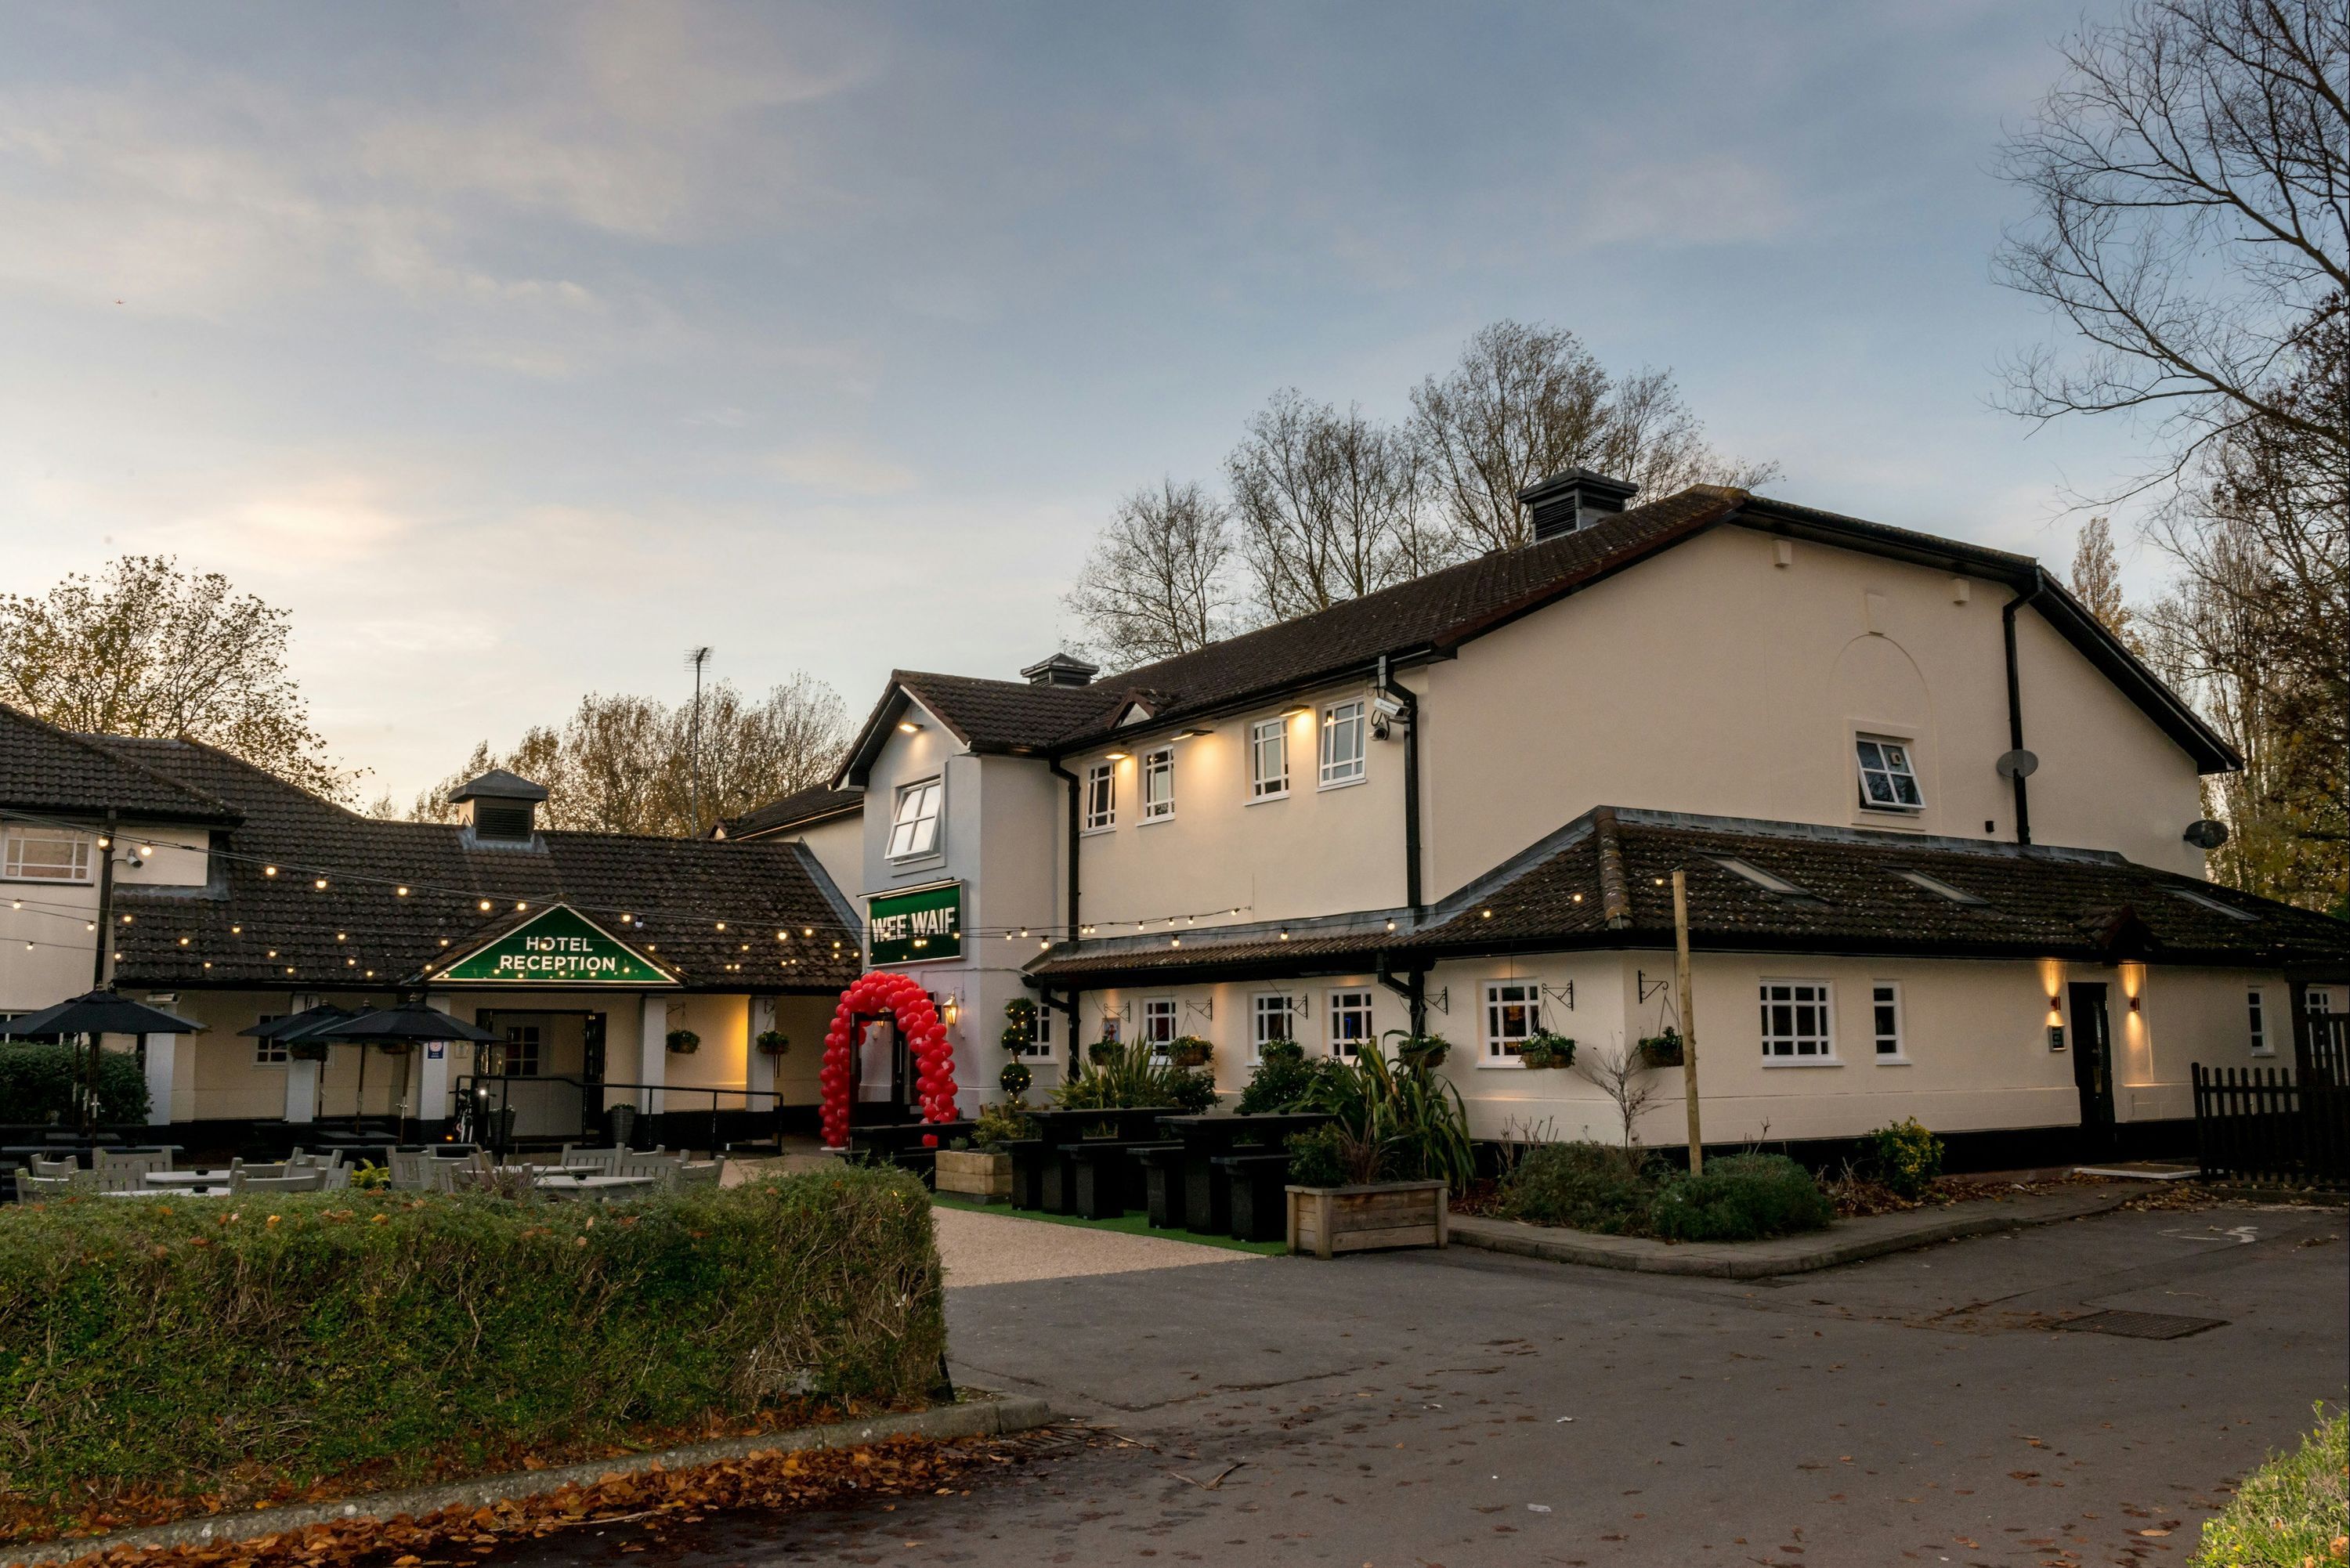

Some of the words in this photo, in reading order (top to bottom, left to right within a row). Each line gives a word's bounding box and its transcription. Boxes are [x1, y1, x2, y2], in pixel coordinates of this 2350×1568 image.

[871, 914, 907, 943] WEE
[911, 907, 956, 937] WAIF
[526, 937, 593, 952] HOTEL
[500, 955, 616, 971] RECEPTION
